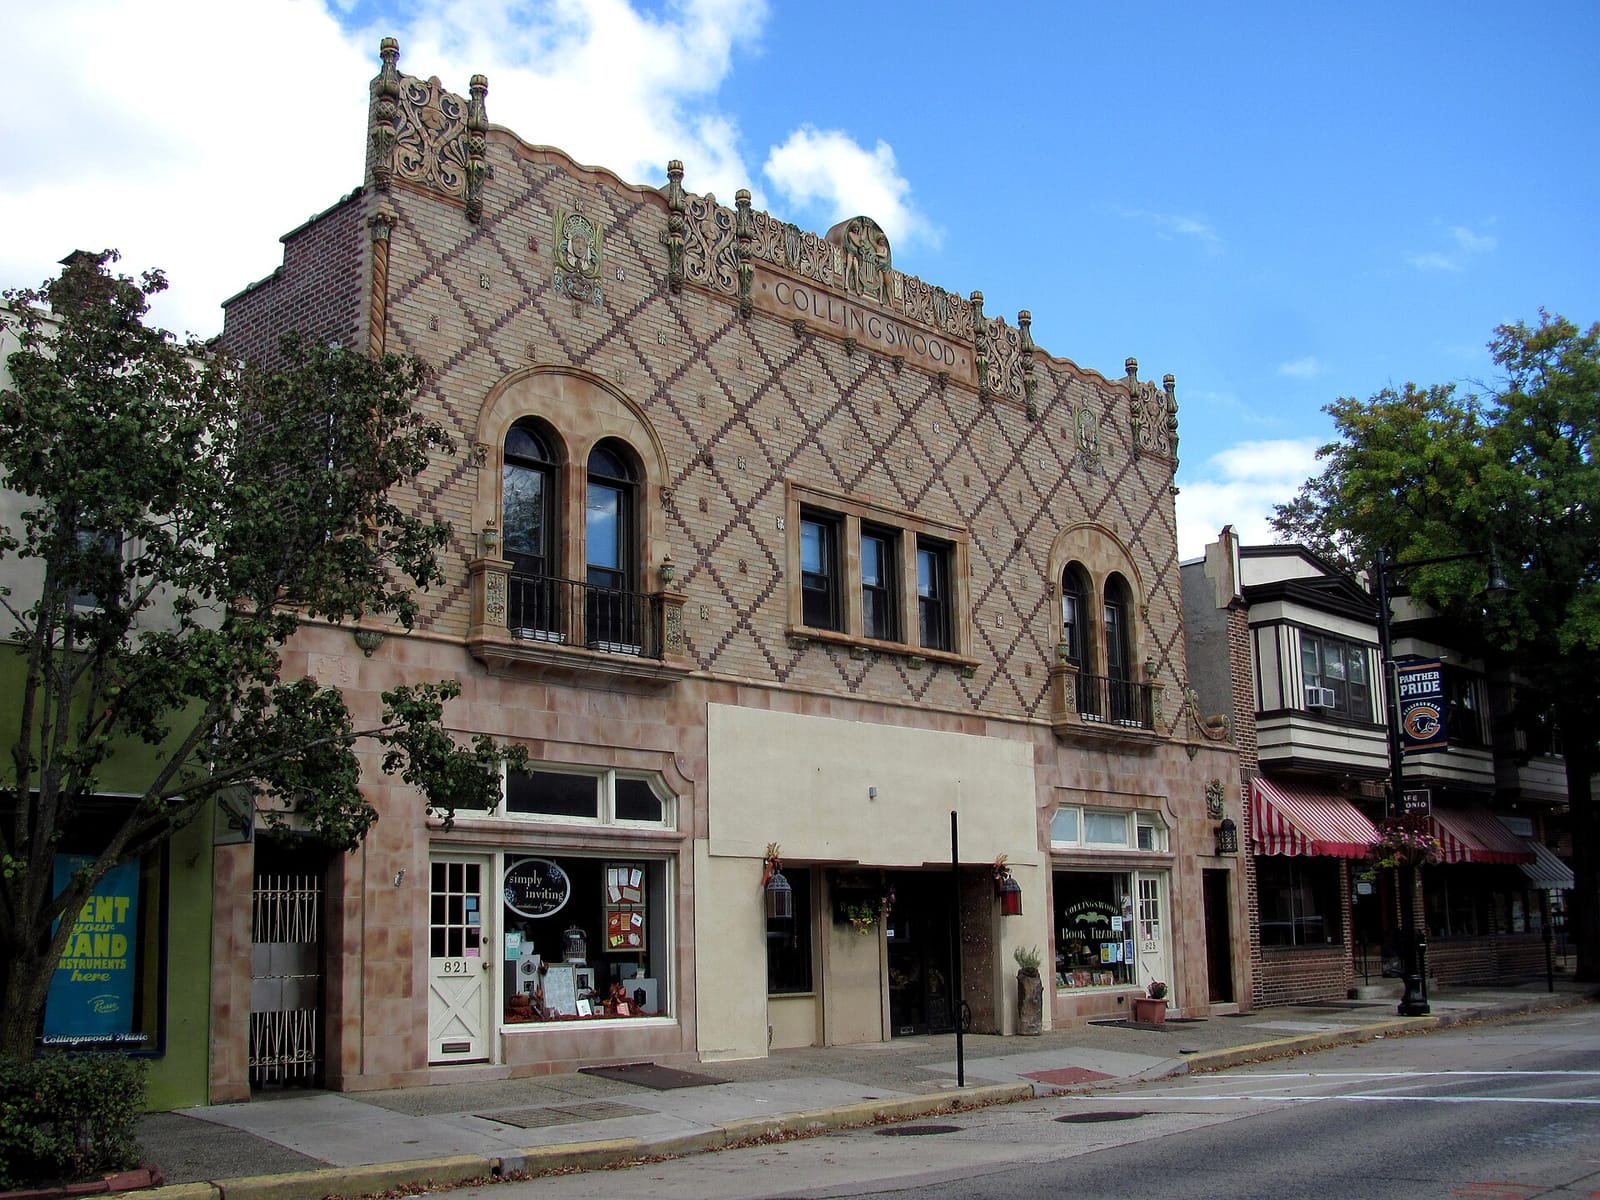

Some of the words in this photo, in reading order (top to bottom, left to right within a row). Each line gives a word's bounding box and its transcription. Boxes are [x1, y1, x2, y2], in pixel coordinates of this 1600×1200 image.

[775, 282, 955, 366] COLLINGSWOOD
[1399, 671, 1440, 684] PANTHER
[1400, 680, 1440, 696] PRIDE
[509, 869, 543, 888] simply
[526, 886, 564, 903] inviting
[59, 896, 130, 923] ENT
[1065, 900, 1119, 917] COLLINGSWOOD
[73, 923, 115, 935] your
[1062, 927, 1086, 940] BOOK
[58, 958, 126, 970] NSTRUMENTS
[444, 961, 468, 973] 821
[71, 969, 112, 982] here
[43, 1032, 113, 1045] Collingswood
[116, 1031, 149, 1041] Music
